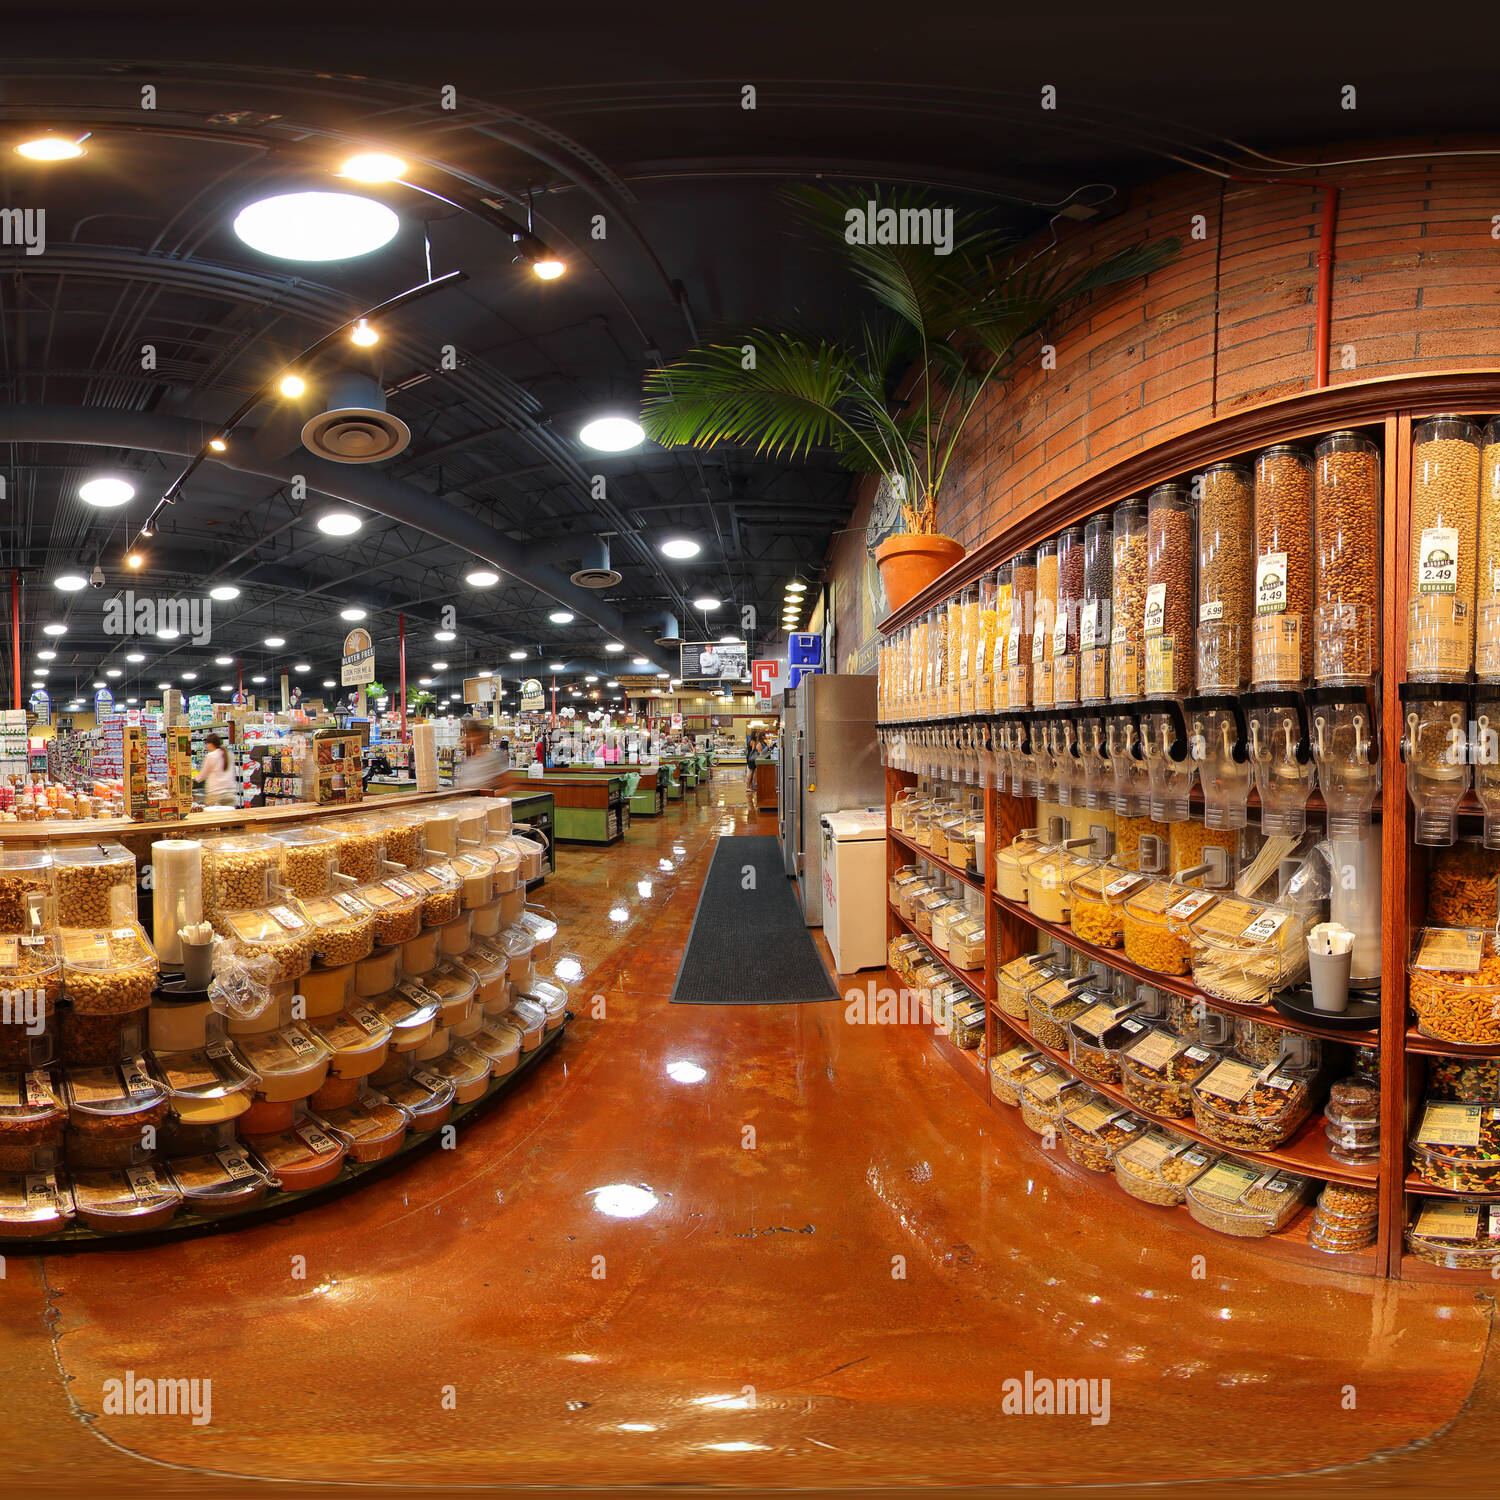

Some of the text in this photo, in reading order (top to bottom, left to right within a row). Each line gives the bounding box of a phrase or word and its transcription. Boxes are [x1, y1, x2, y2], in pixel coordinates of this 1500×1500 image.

[1424, 569, 1452, 580] 2.49
[1260, 590, 1282, 601] 4.49
[361, 648, 374, 658] FREE
